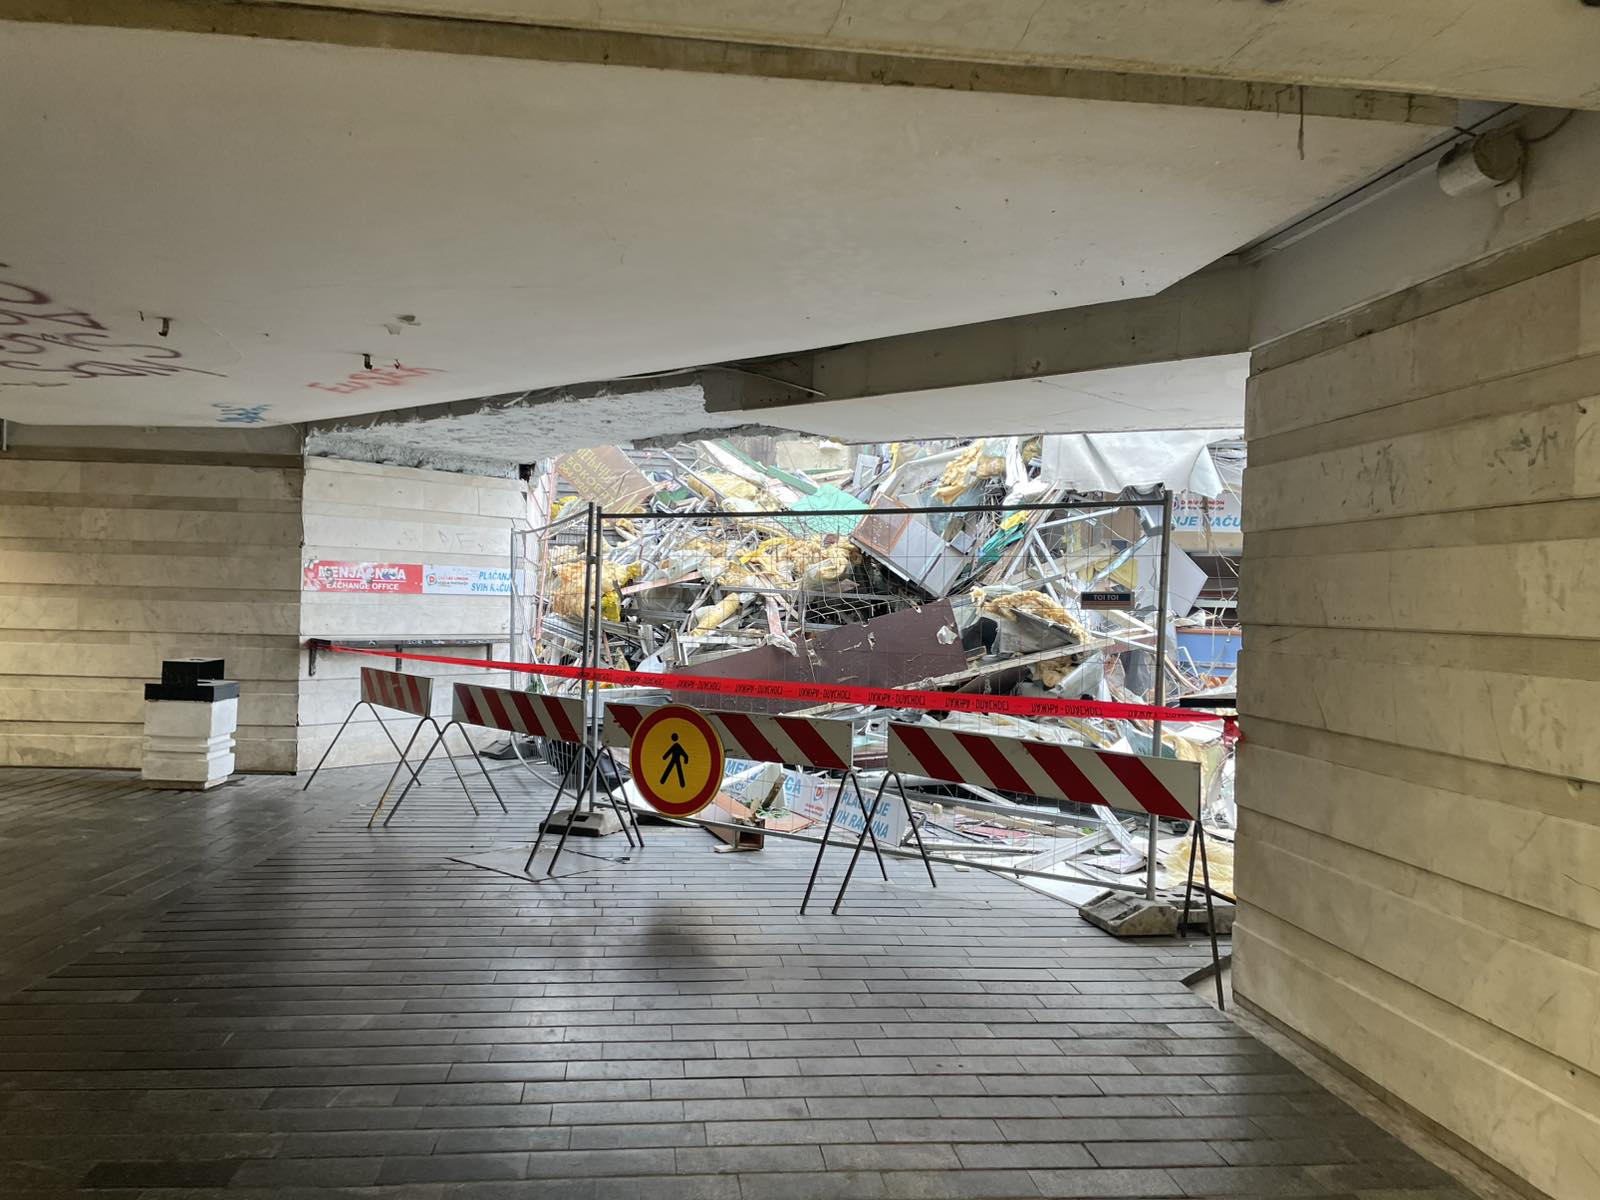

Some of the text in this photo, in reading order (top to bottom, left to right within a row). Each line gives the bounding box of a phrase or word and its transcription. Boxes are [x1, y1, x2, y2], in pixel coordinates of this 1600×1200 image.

[318, 565, 406, 580] MENJANA
[326, 581, 399, 591] EXCHANGE OFFICE
[841, 790, 890, 817] PLAAJE
[848, 814, 889, 838] RANA
